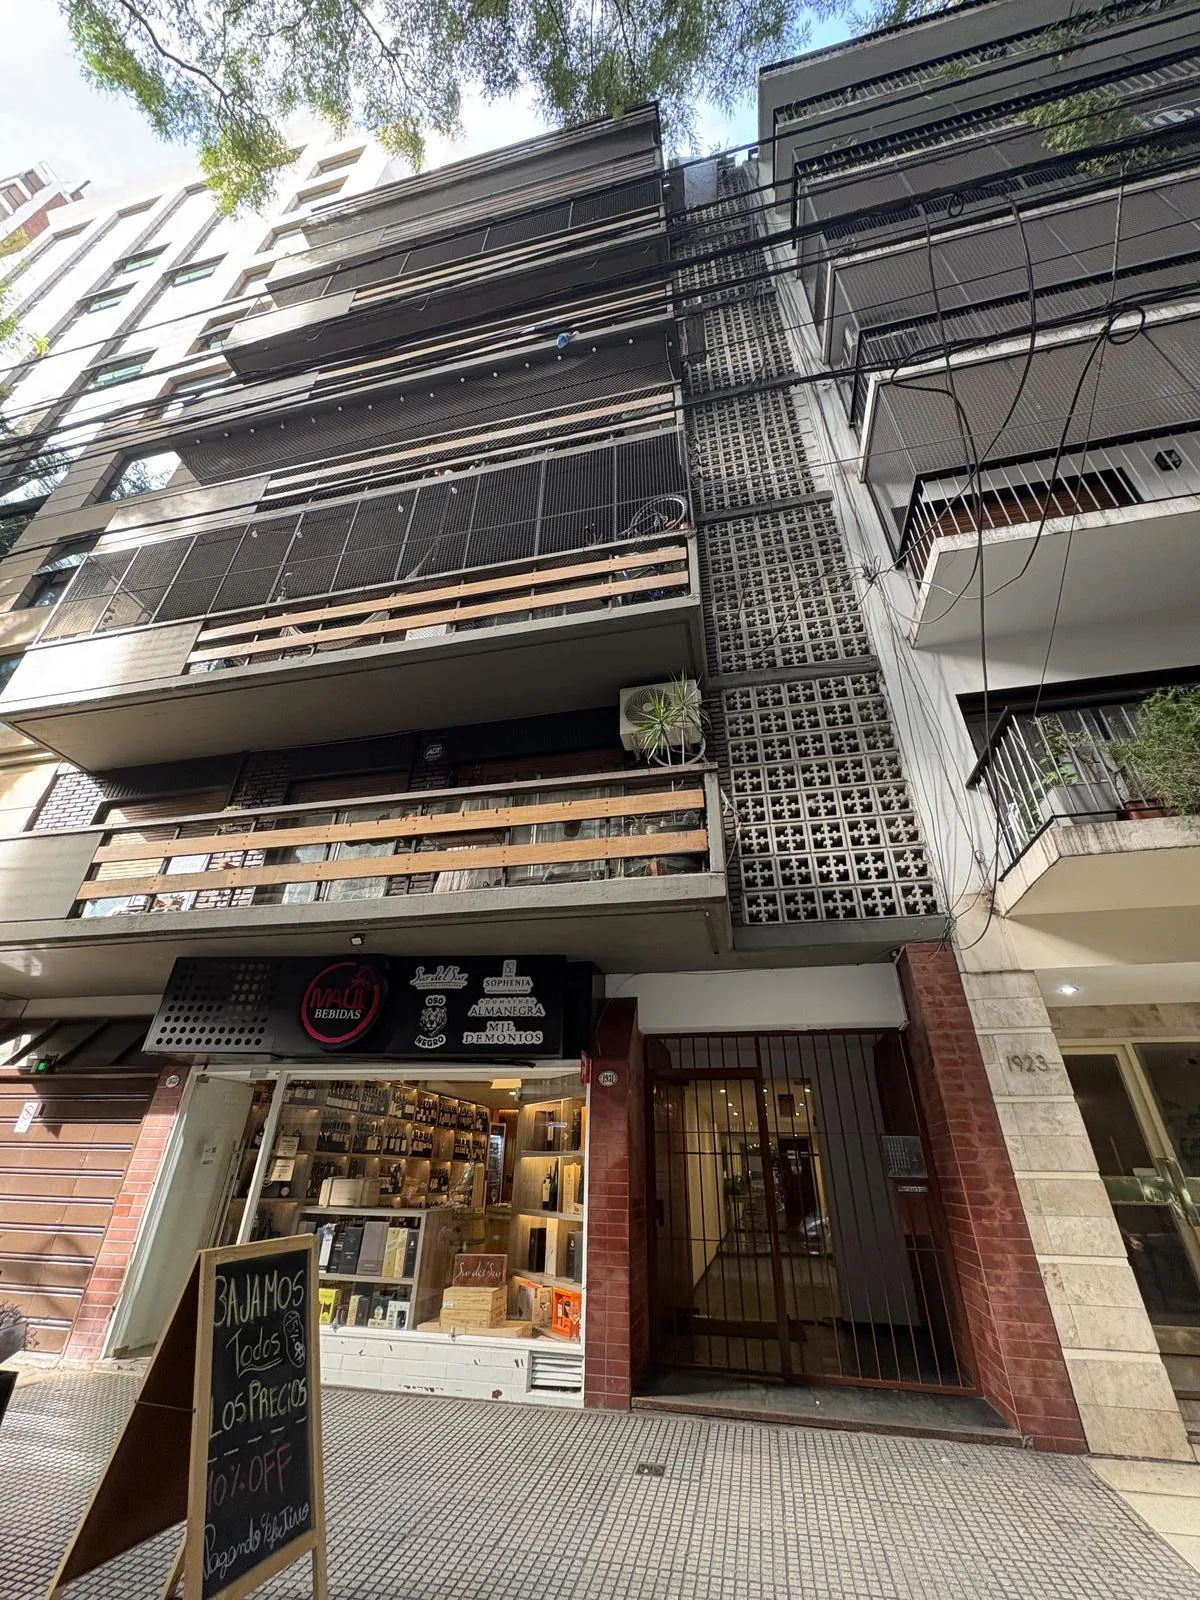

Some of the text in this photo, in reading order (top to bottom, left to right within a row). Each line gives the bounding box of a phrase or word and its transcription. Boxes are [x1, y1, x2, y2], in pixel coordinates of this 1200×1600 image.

[484, 979, 531, 987] SOPHENIA
[427, 997, 445, 1005] OSO
[314, 1008, 361, 1019] BEBIDAS
[470, 1005, 543, 1016] ALMANEGRA
[488, 1022, 514, 1032] MIL
[416, 1035, 445, 1048] NEGRO
[465, 1032, 542, 1043] DEMONIOS
[1006, 1054, 1049, 1073] 1923
[213, 1270, 305, 1328] BAJAMOS
[226, 1326, 281, 1375] Todos
[207, 1443, 293, 1514] 10% OFF
